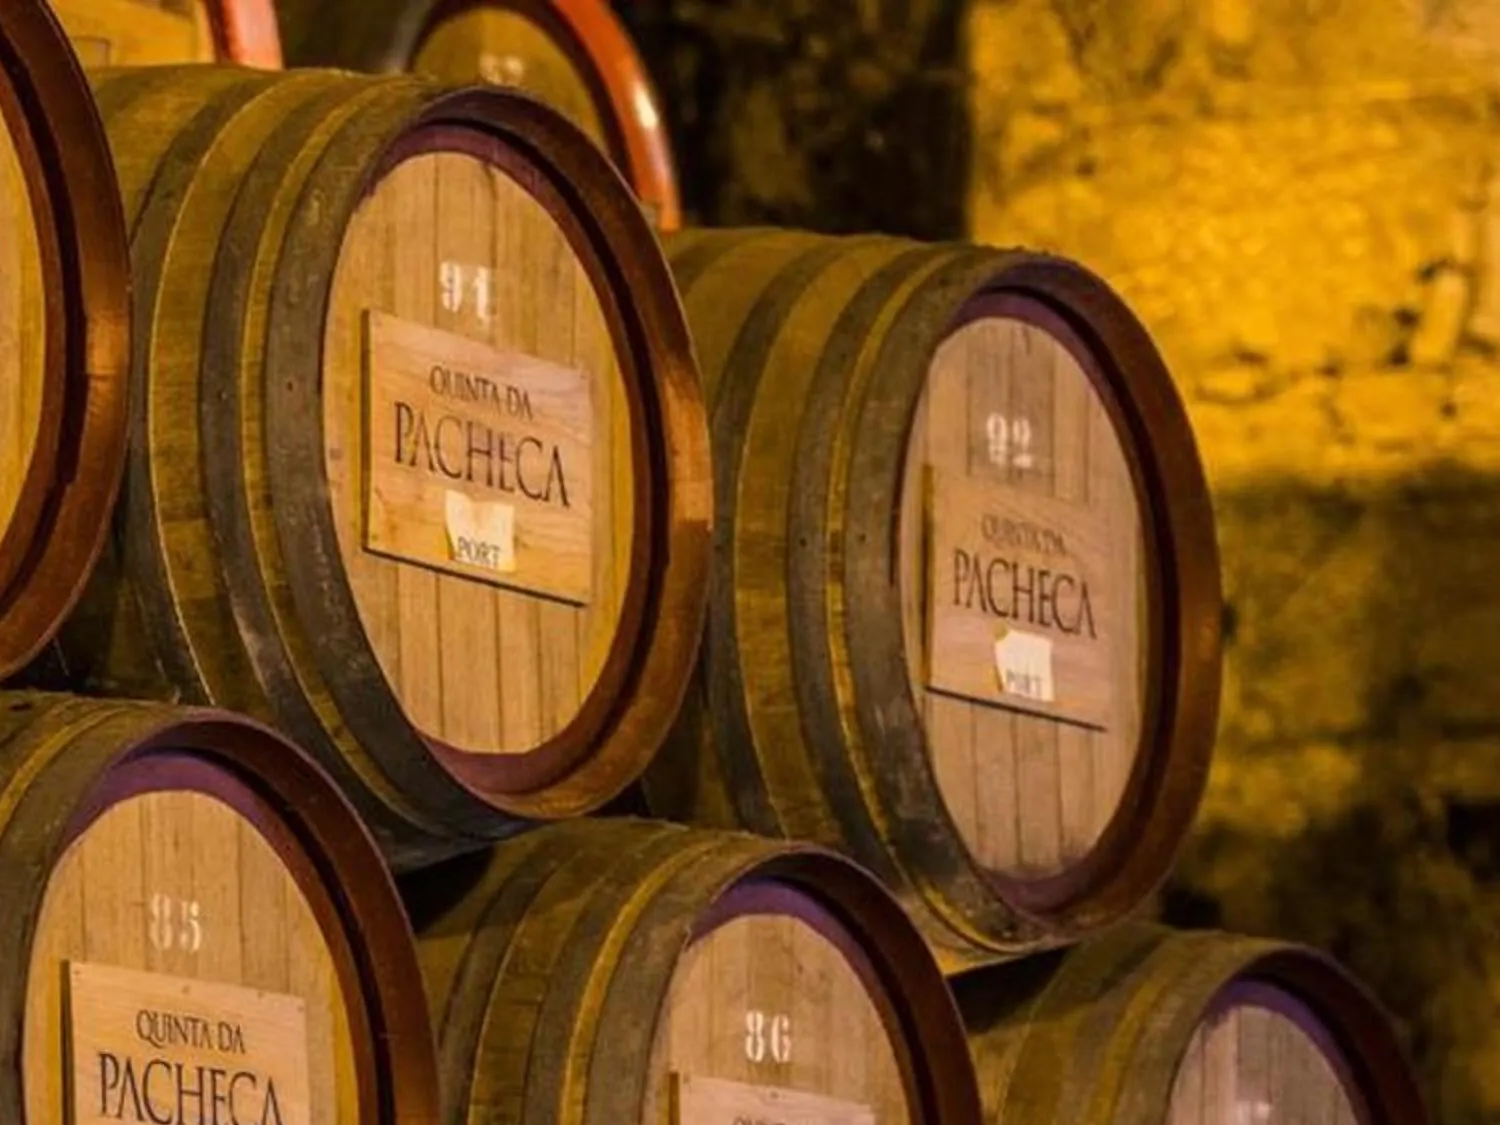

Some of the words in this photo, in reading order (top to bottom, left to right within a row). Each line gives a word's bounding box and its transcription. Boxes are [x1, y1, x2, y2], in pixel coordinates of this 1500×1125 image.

[439, 261, 491, 329] 91
[430, 366, 498, 402] QUINTA
[506, 385, 533, 420] DA
[394, 401, 571, 508] PACHECA
[457, 536, 502, 568] PORT
[953, 547, 1098, 640] PACHECA
[136, 1009, 214, 1050] QUINTA
[217, 1021, 246, 1054] DA
